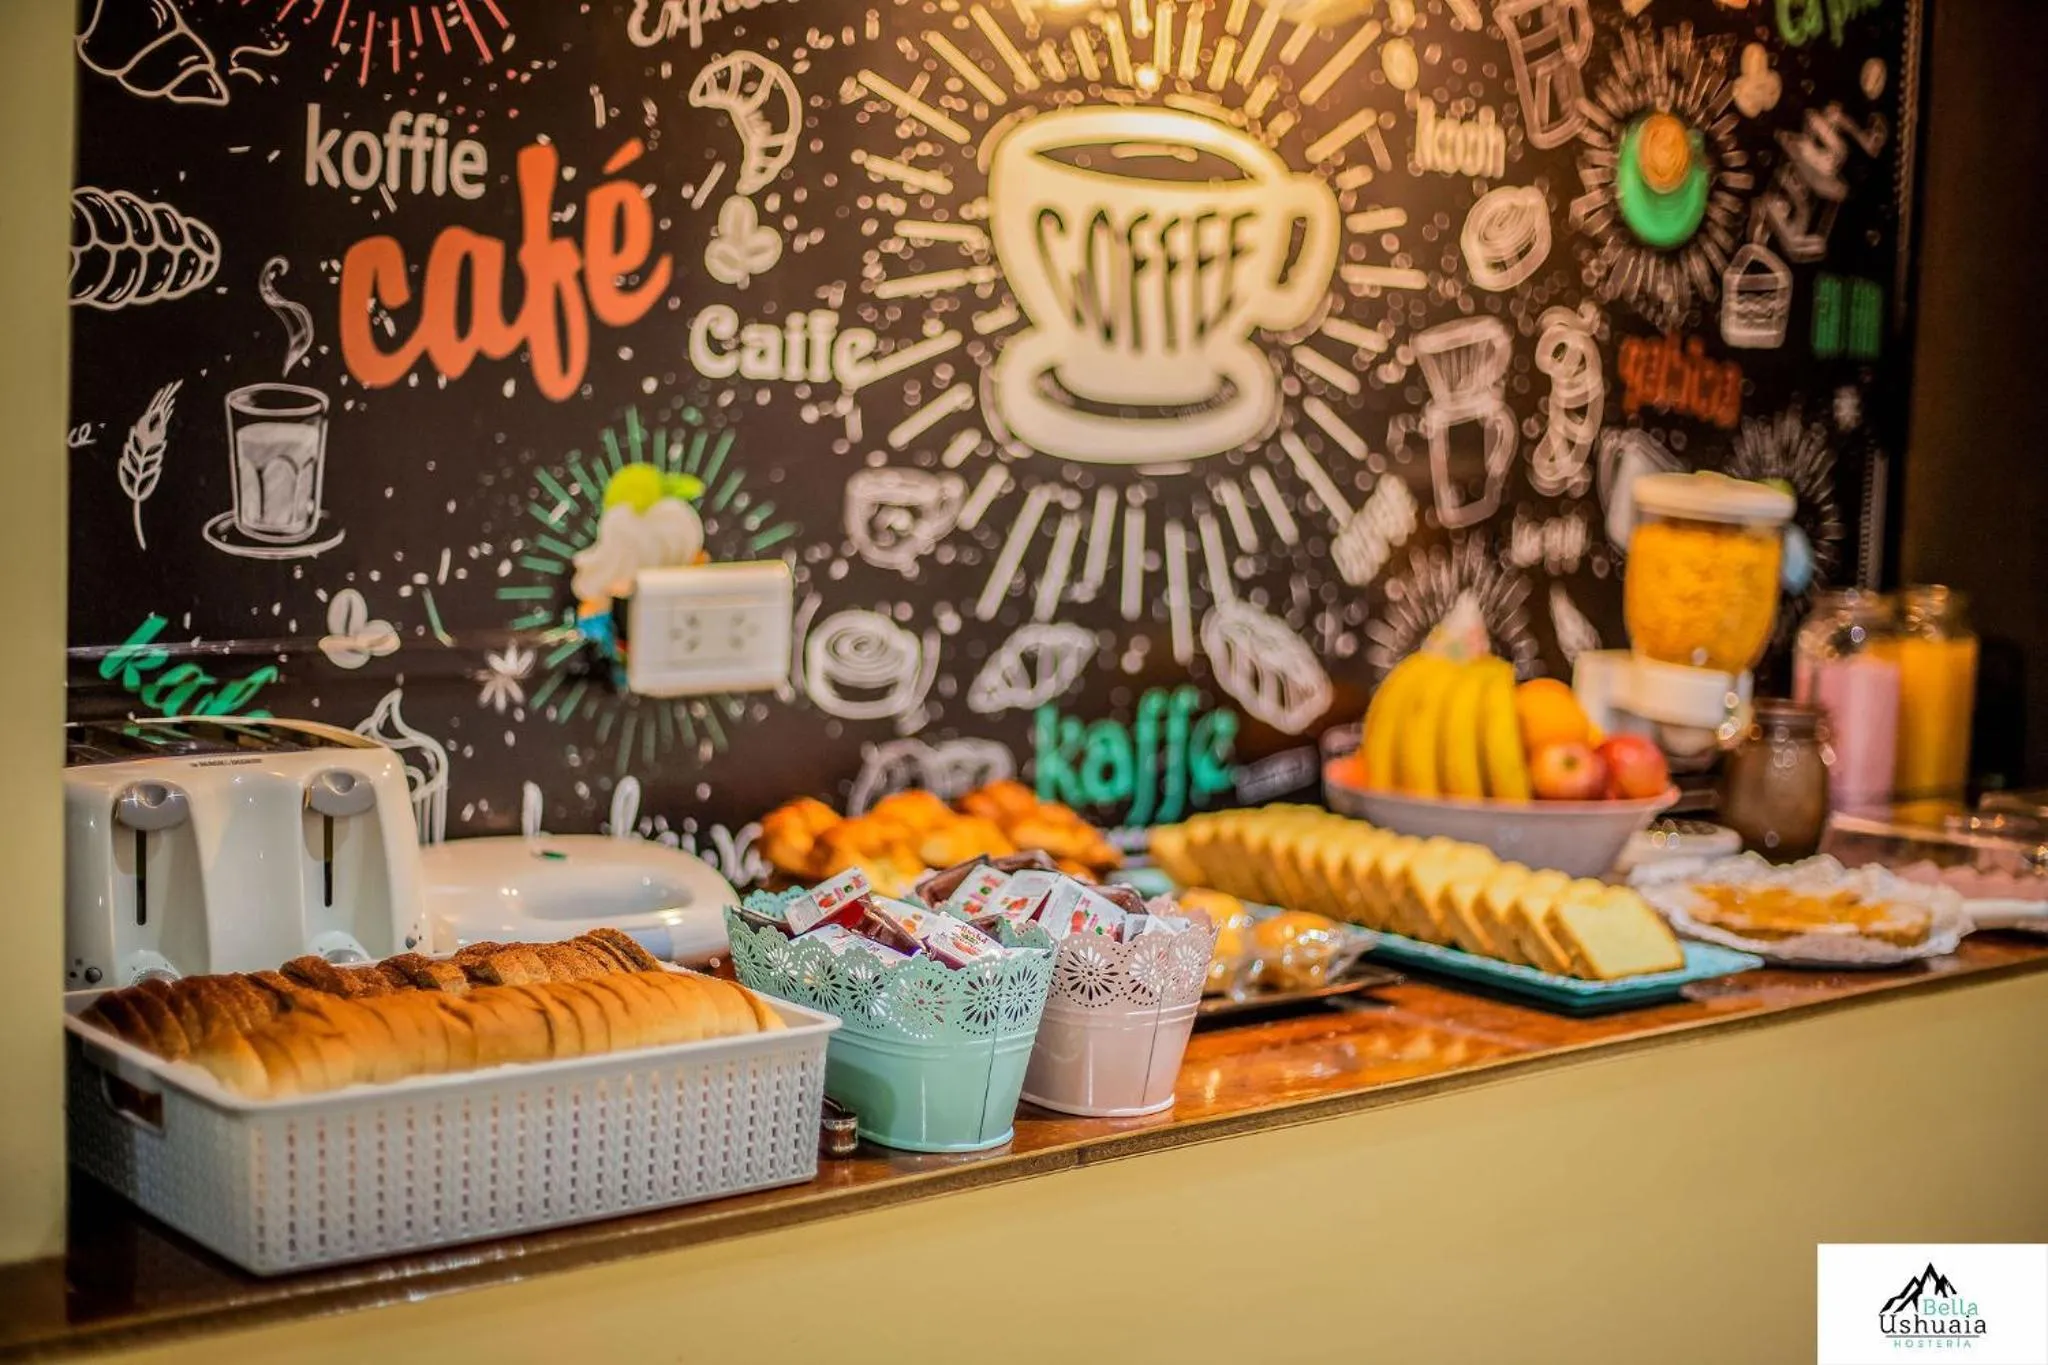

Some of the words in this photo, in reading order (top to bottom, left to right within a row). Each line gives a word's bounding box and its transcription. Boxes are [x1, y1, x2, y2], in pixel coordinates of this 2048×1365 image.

[305, 103, 488, 200] koffie
[339, 137, 672, 402] café
[1036, 685, 1238, 826] kaffe
